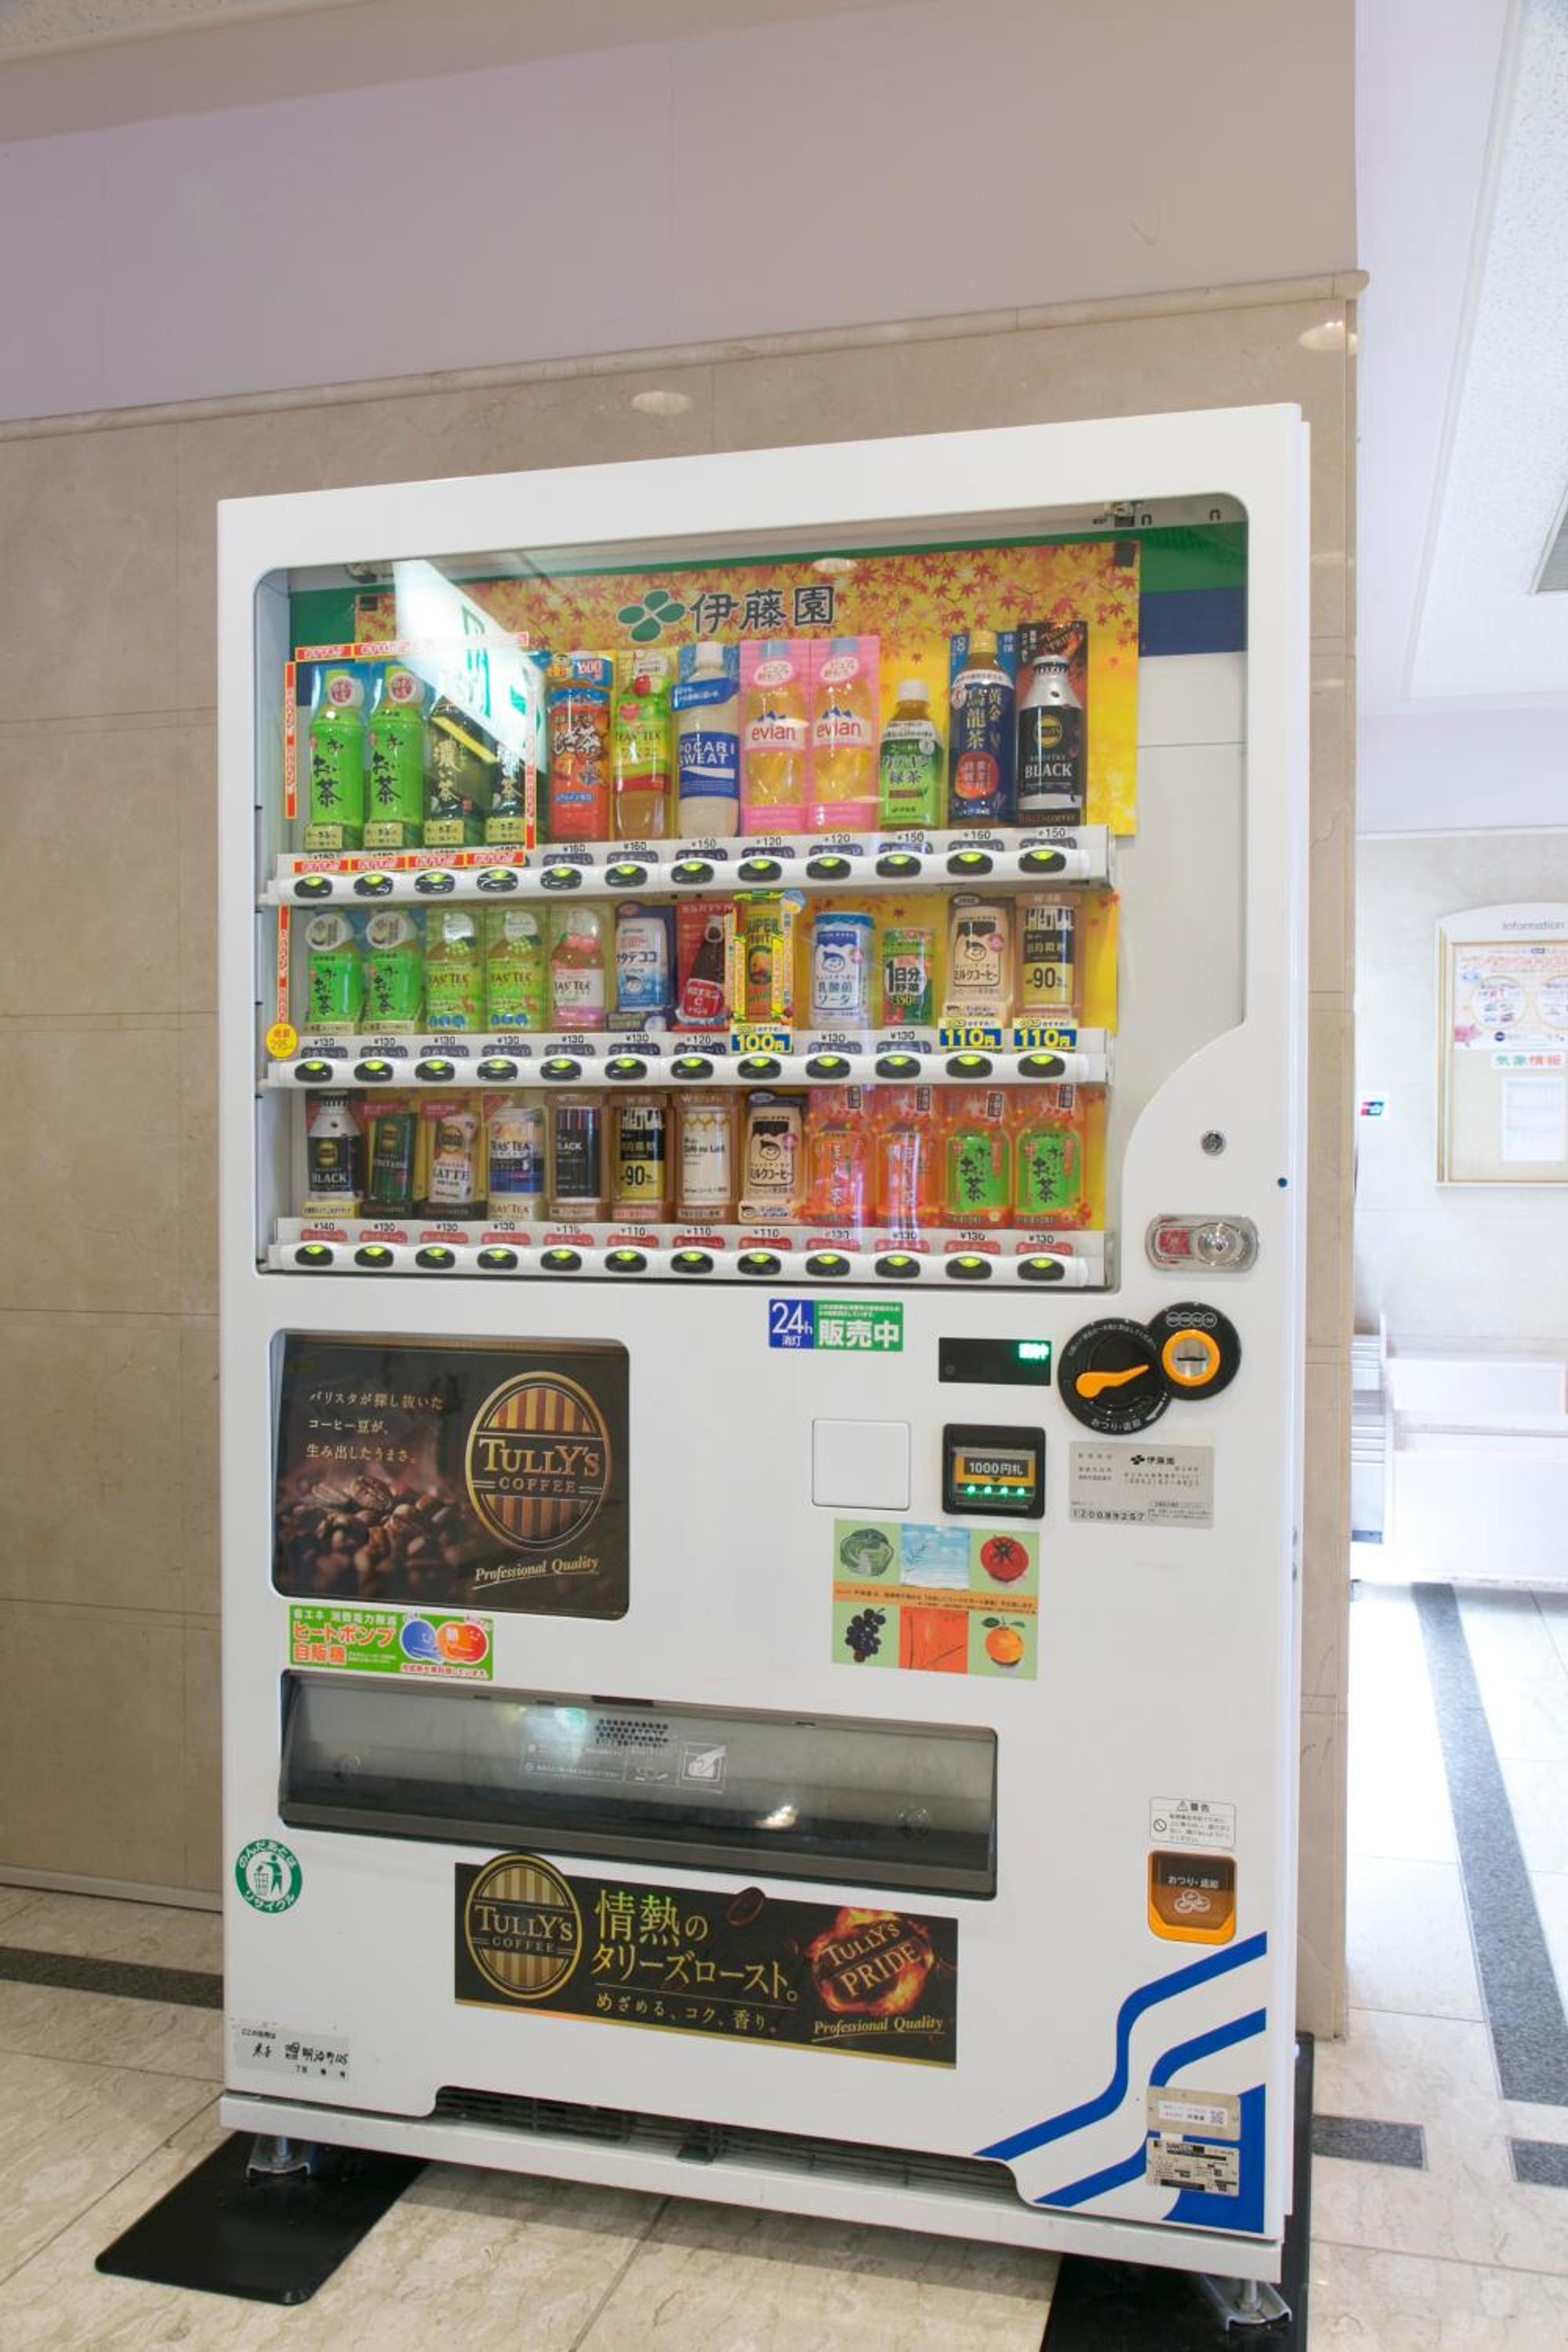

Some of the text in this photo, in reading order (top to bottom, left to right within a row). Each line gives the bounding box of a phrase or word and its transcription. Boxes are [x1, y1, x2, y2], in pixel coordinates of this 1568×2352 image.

[690, 585, 835, 632] 伊藤園
[751, 725, 796, 742] evian
[817, 722, 862, 738] evian
[1025, 763, 1072, 778] BLACK
[818, 1319, 899, 1348] 販売中
[479, 1438, 600, 1477] TULLY'S
[969, 1460, 1024, 1476] 1000円札
[499, 1477, 577, 1493] COFFEE
[475, 1556, 599, 1582] Professional Quality
[293, 1621, 396, 1648] ヒートポンプ
[475, 1905, 573, 1941] TULLY'S
[595, 1889, 708, 1948] 情熱の
[492, 1937, 556, 1953] COFFEE
[822, 1922, 901, 1967] TULLY'S
[590, 1944, 798, 2002] タリーズロースト。
[840, 1942, 921, 1998] PRIDE
[815, 2015, 944, 2037] Professional Quality
